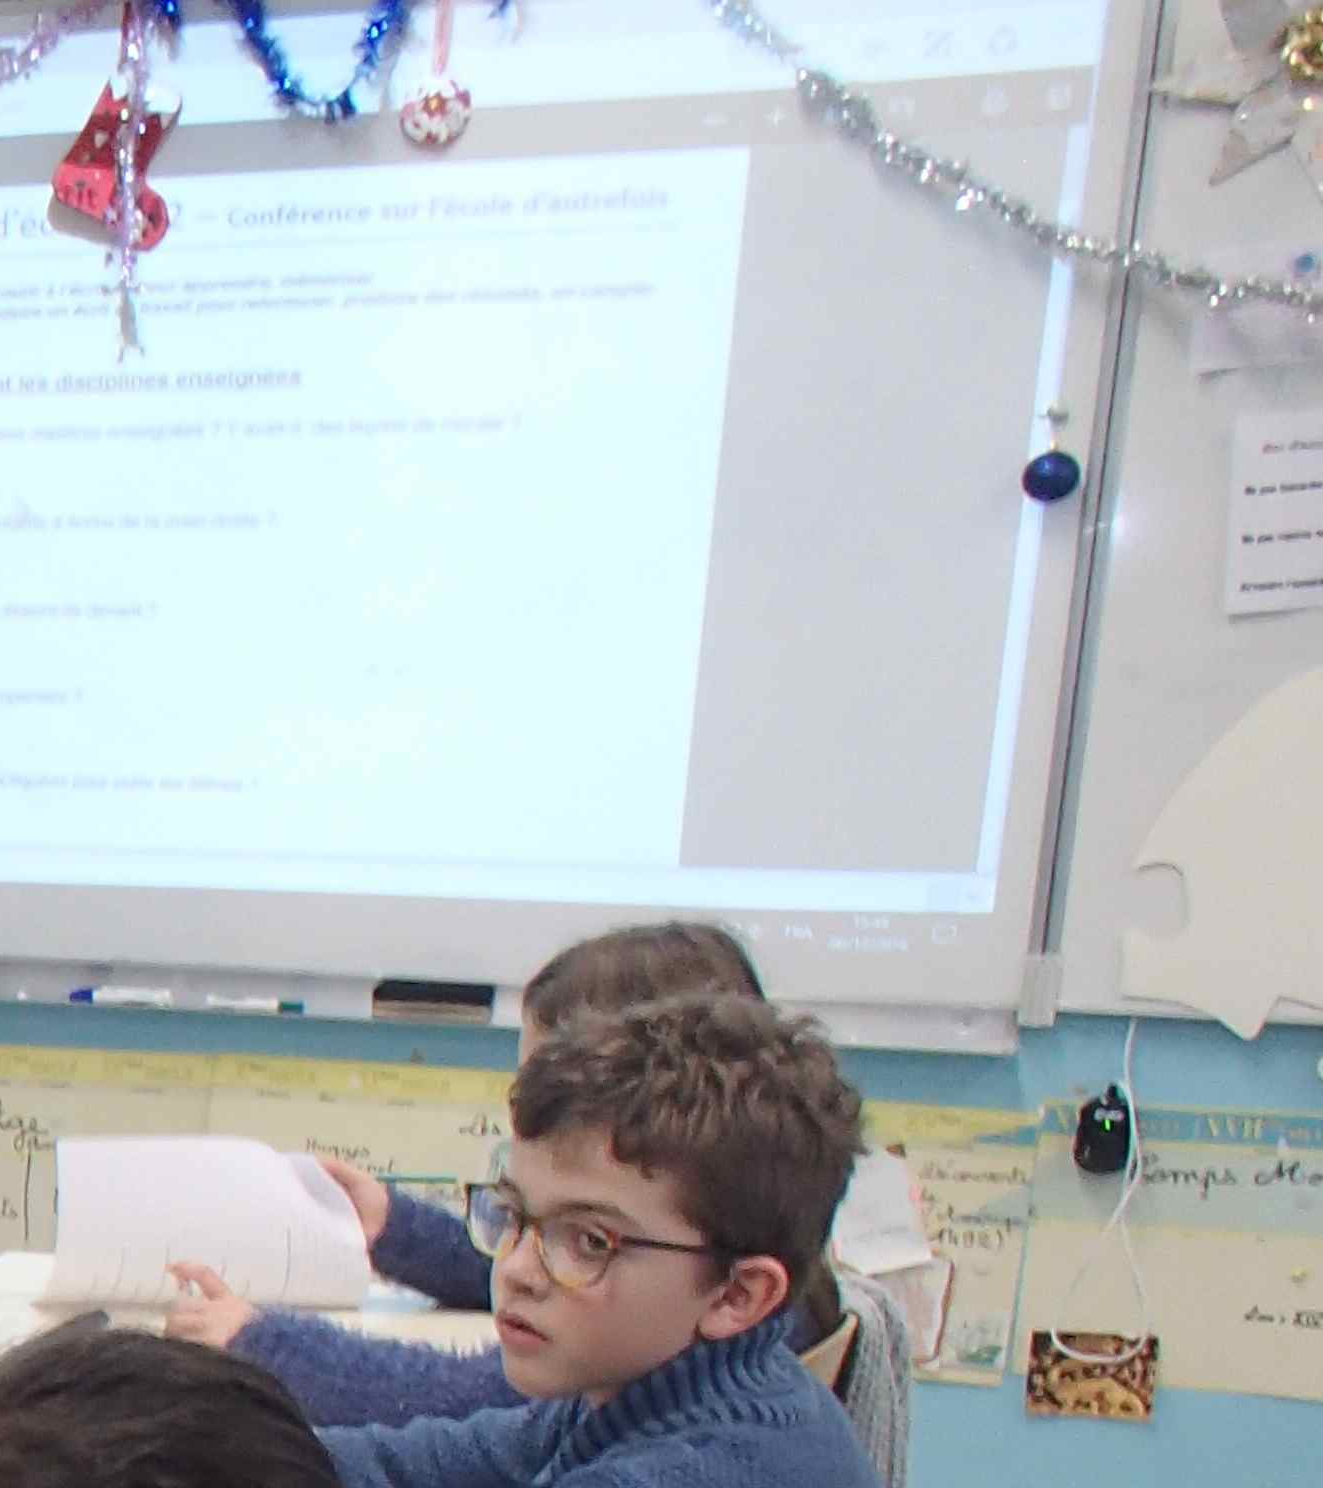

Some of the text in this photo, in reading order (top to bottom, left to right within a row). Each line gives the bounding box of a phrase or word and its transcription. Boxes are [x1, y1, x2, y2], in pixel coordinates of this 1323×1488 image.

[227, 201, 370, 230] Conférence
[380, 202, 418, 222] sur
[19, 373, 49, 393] les
